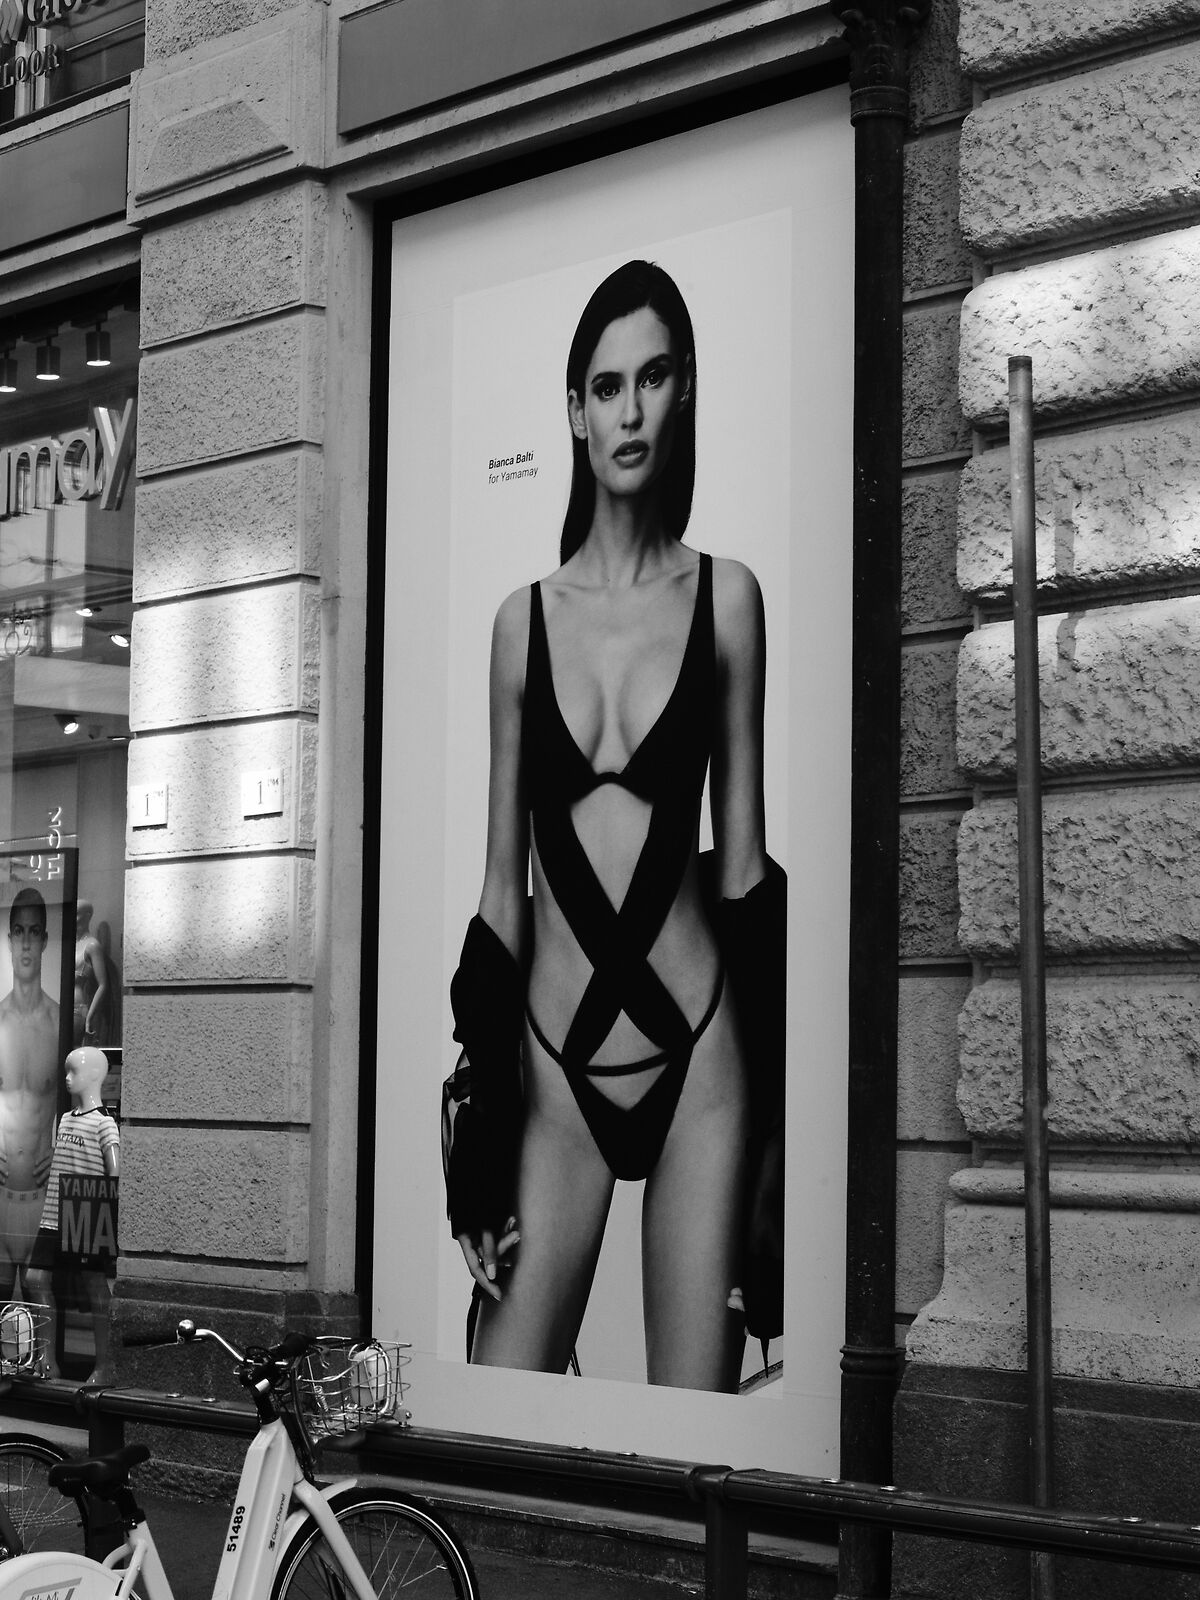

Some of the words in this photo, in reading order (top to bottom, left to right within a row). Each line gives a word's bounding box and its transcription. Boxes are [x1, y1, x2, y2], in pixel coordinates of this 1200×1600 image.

[488, 458, 514, 470] Bianca
[516, 450, 534, 464] Balti
[488, 473, 499, 484] for
[501, 467, 539, 482] Yamamay
[226, 1505, 246, 1552] 51489
